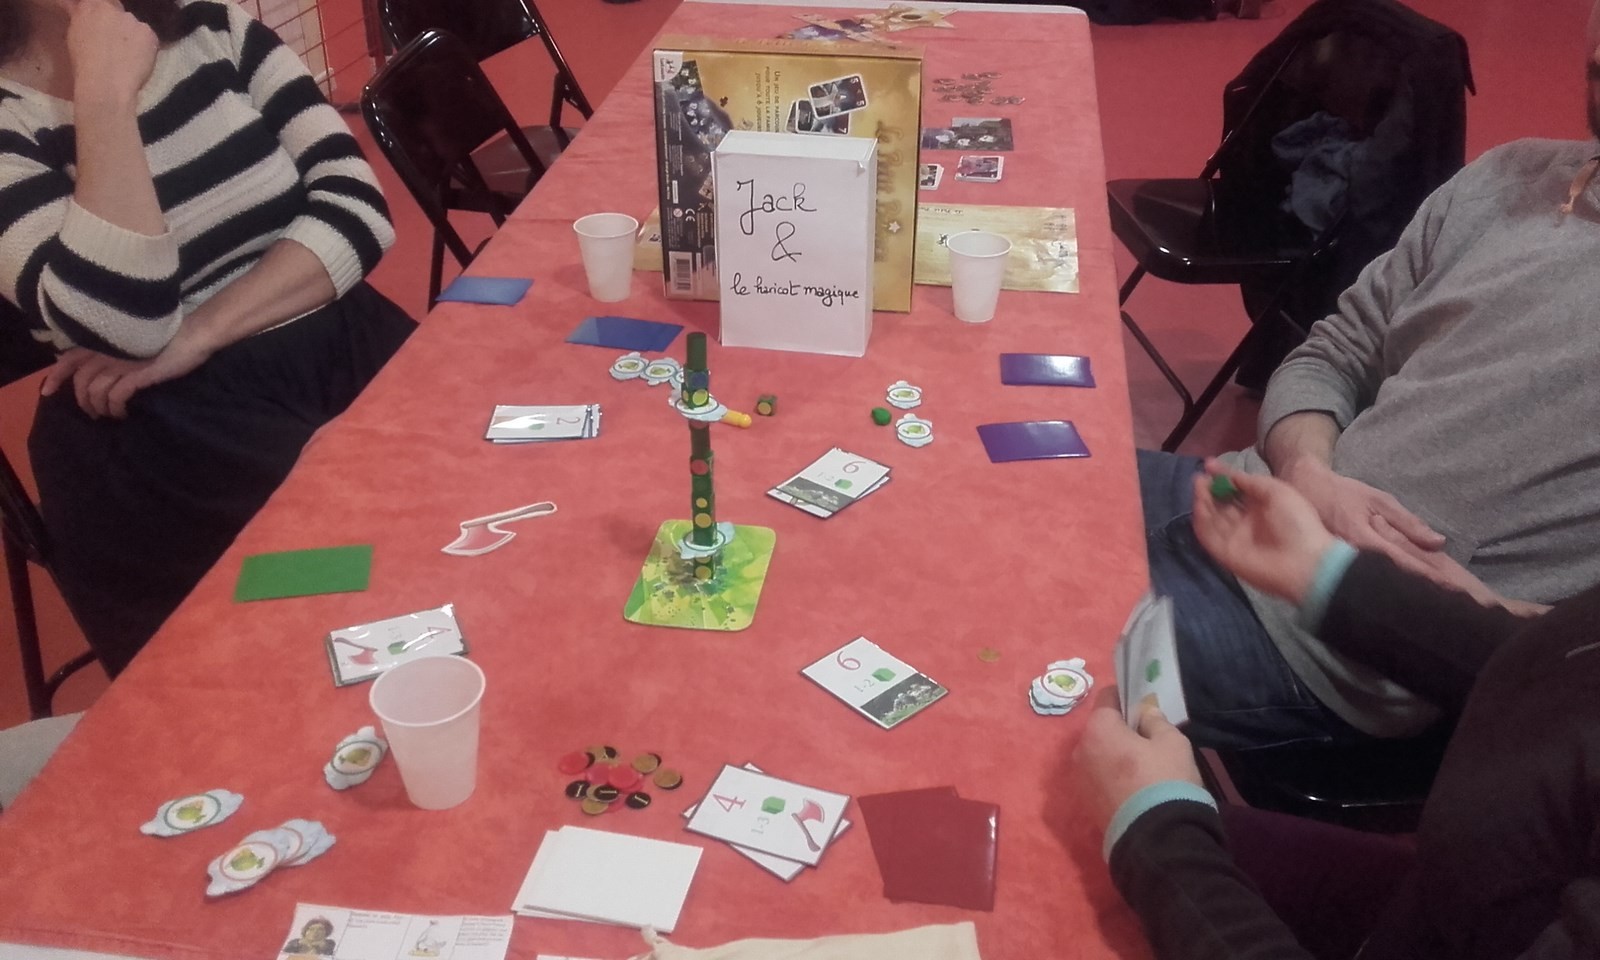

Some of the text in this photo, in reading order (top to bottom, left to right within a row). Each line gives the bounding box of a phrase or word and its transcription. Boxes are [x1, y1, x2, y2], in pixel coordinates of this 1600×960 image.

[736, 179, 817, 236] Jack
[771, 221, 802, 263] &
[730, 272, 860, 307] le haricot magique
[836, 650, 861, 671] 6
[713, 793, 747, 813] 4
